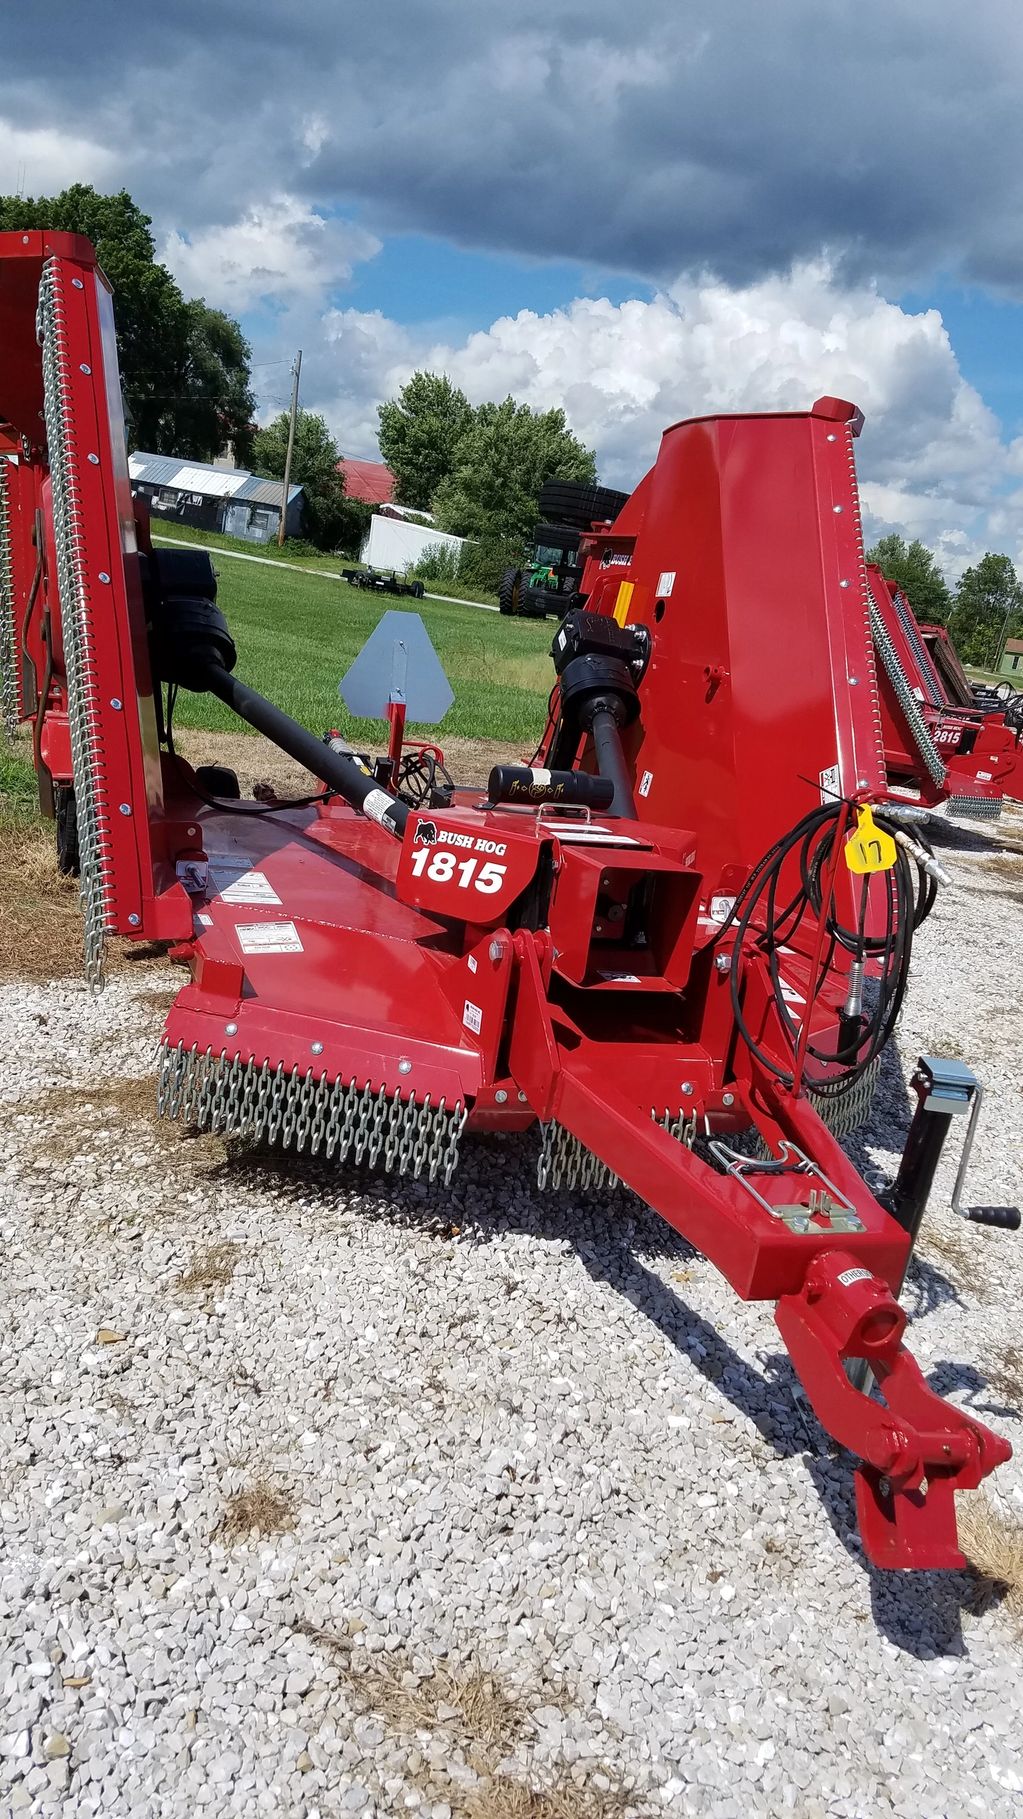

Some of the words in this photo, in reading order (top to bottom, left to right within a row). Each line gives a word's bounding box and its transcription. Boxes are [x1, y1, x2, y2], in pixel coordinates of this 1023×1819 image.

[933, 731, 961, 744] 2815
[437, 830, 475, 849] BUSH
[474, 838, 508, 857] HOG
[859, 840, 882, 864] 17
[410, 847, 508, 894] 1815
